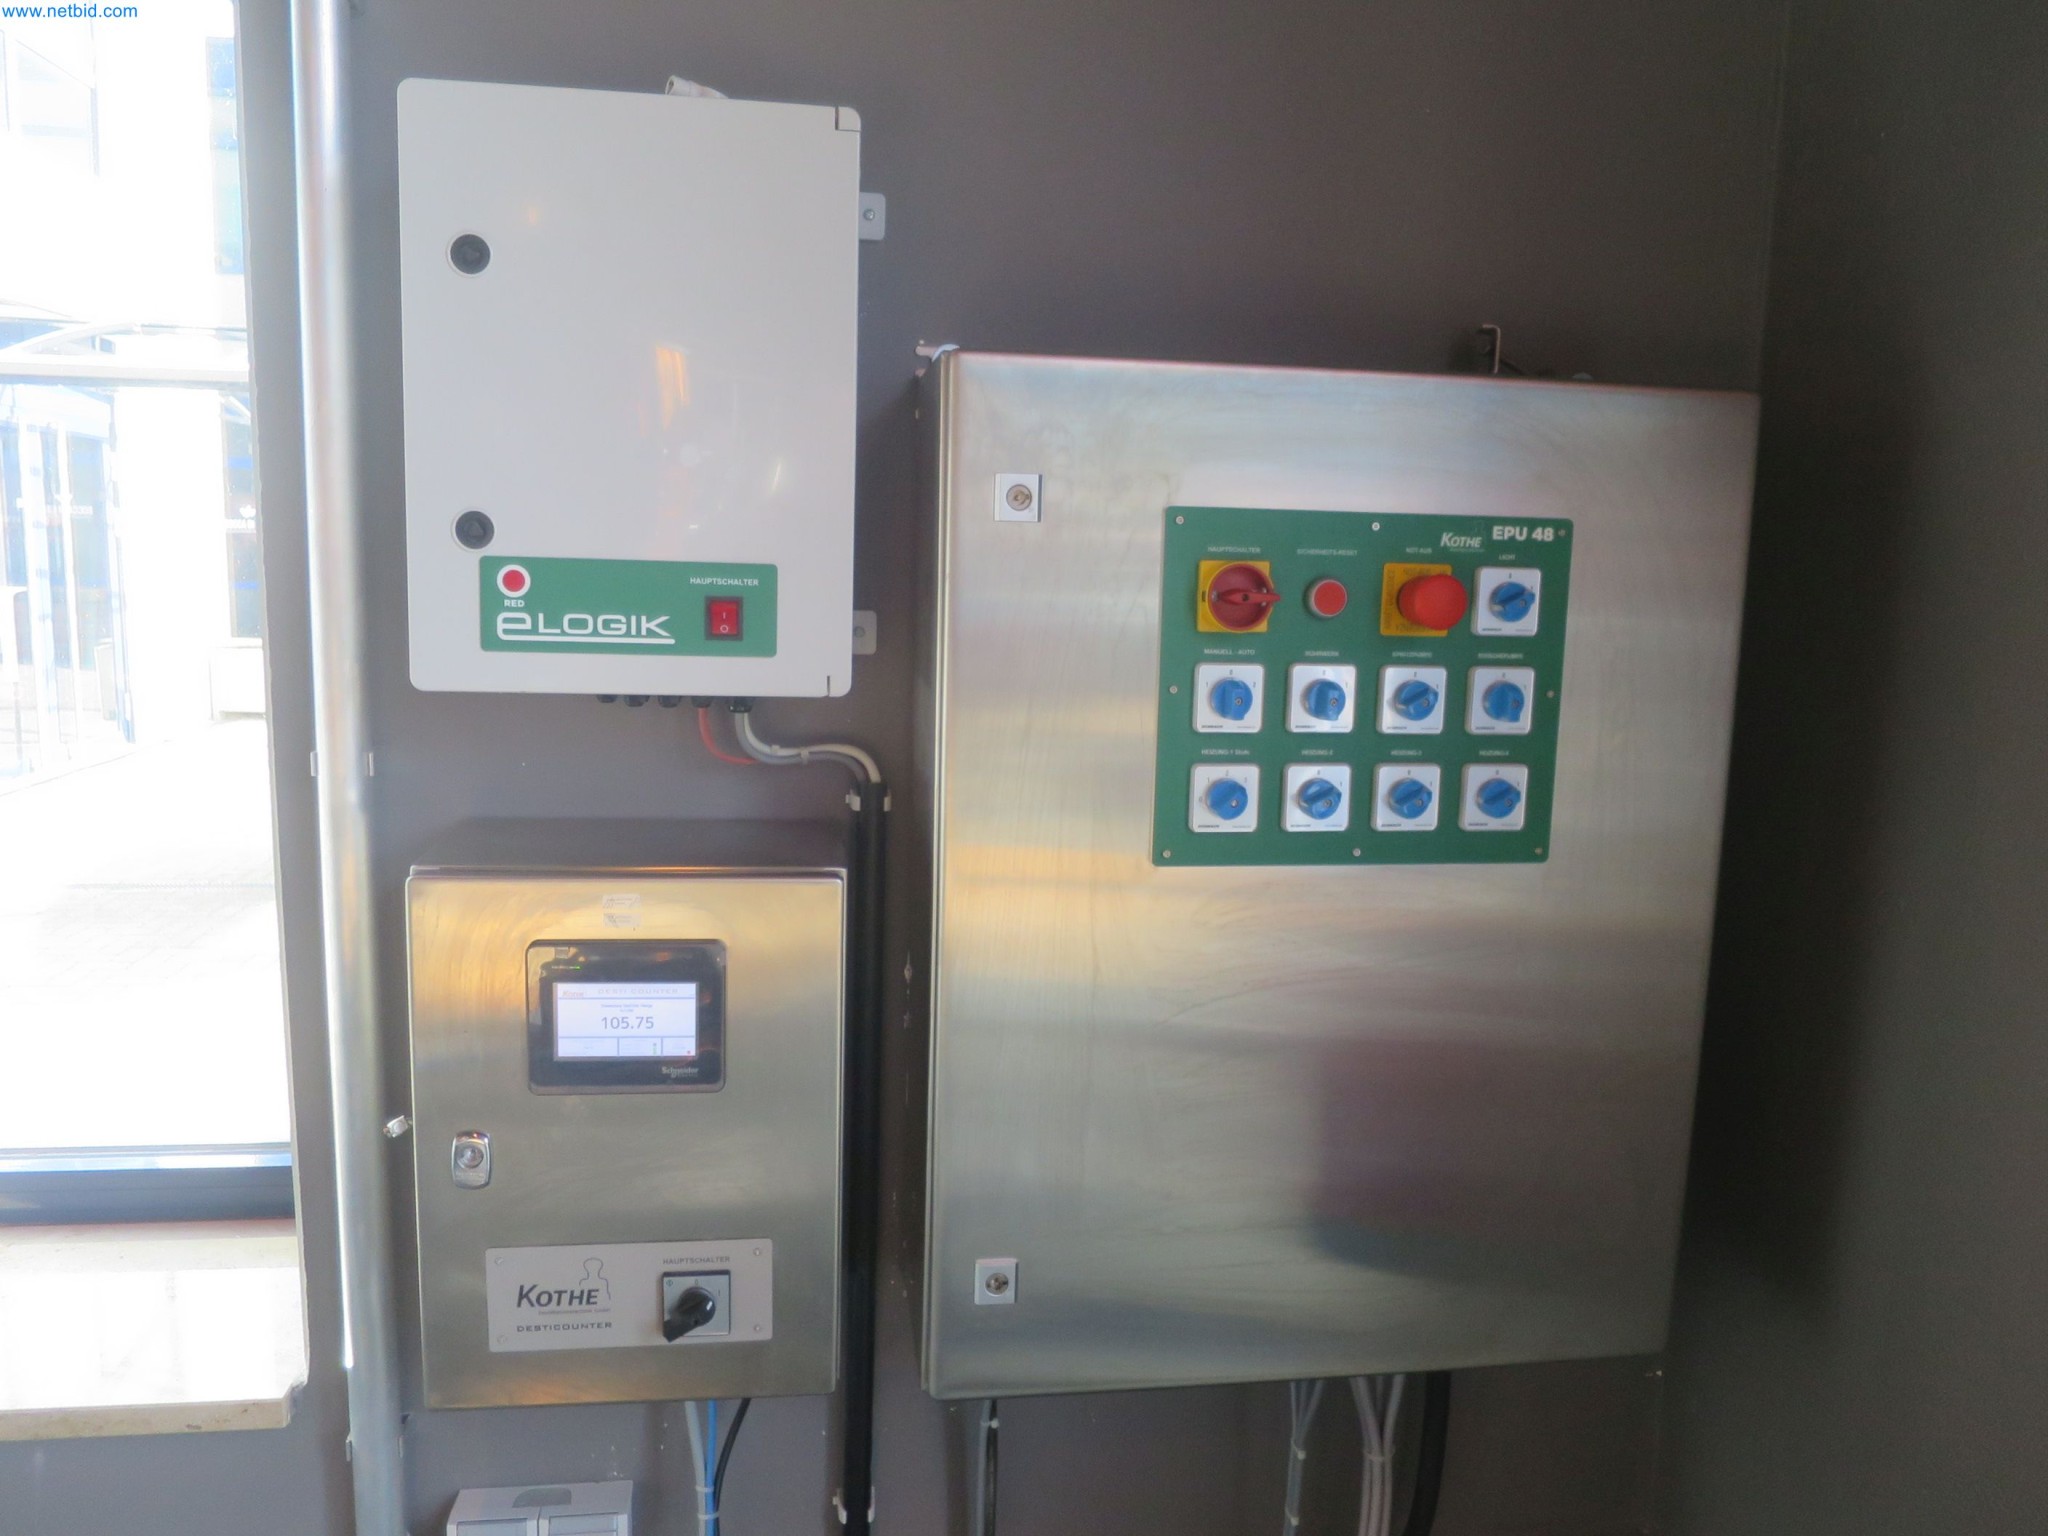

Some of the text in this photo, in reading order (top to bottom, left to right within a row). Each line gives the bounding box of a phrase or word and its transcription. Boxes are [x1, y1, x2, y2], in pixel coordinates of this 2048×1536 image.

[1492, 525, 1555, 542] EPU 48
[689, 577, 759, 587] HAUPTSCHALTER
[503, 599, 525, 608] RED
[1238, 649, 1256, 657] AUTO
[601, 1016, 654, 1029] 105.75
[662, 1256, 731, 1265] HAUPTSCHALTER
[516, 1284, 599, 1308] KOTHE
[516, 1321, 612, 1332] DESTICOUNTER
